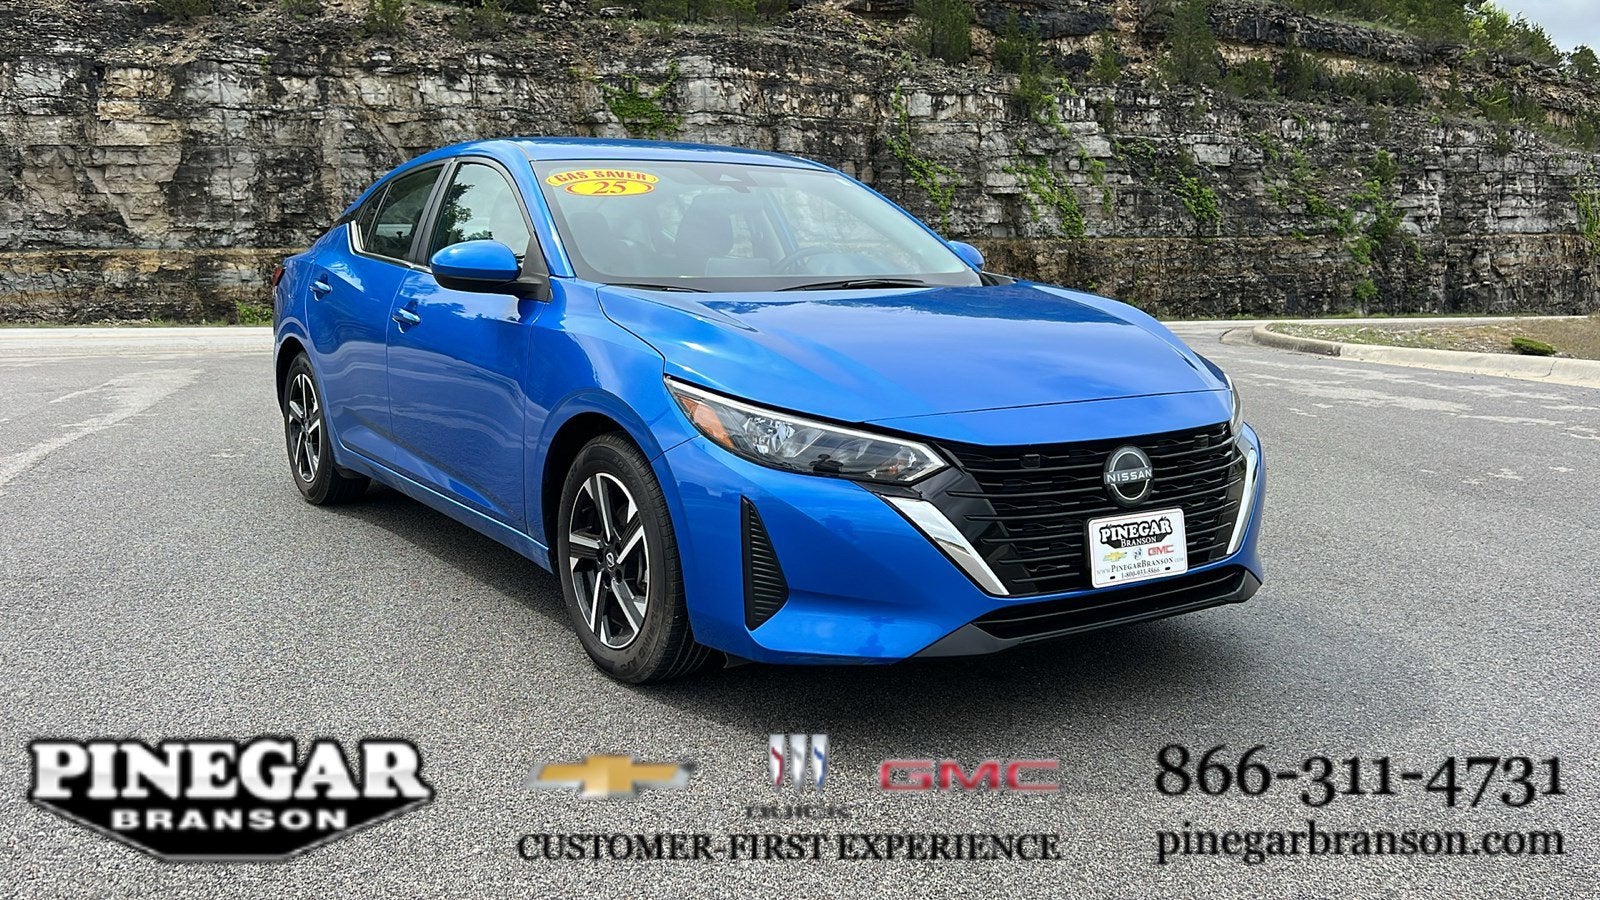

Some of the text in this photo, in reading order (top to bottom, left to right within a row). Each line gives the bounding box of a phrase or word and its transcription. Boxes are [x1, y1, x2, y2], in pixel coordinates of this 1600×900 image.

[554, 170, 647, 182] GAS SAVER
[592, 180, 628, 194] 25
[1106, 468, 1152, 483] NISSAN
[1100, 519, 1172, 543] PINEGAR
[1121, 535, 1157, 548] BRANSON
[1147, 544, 1174, 556] GMC
